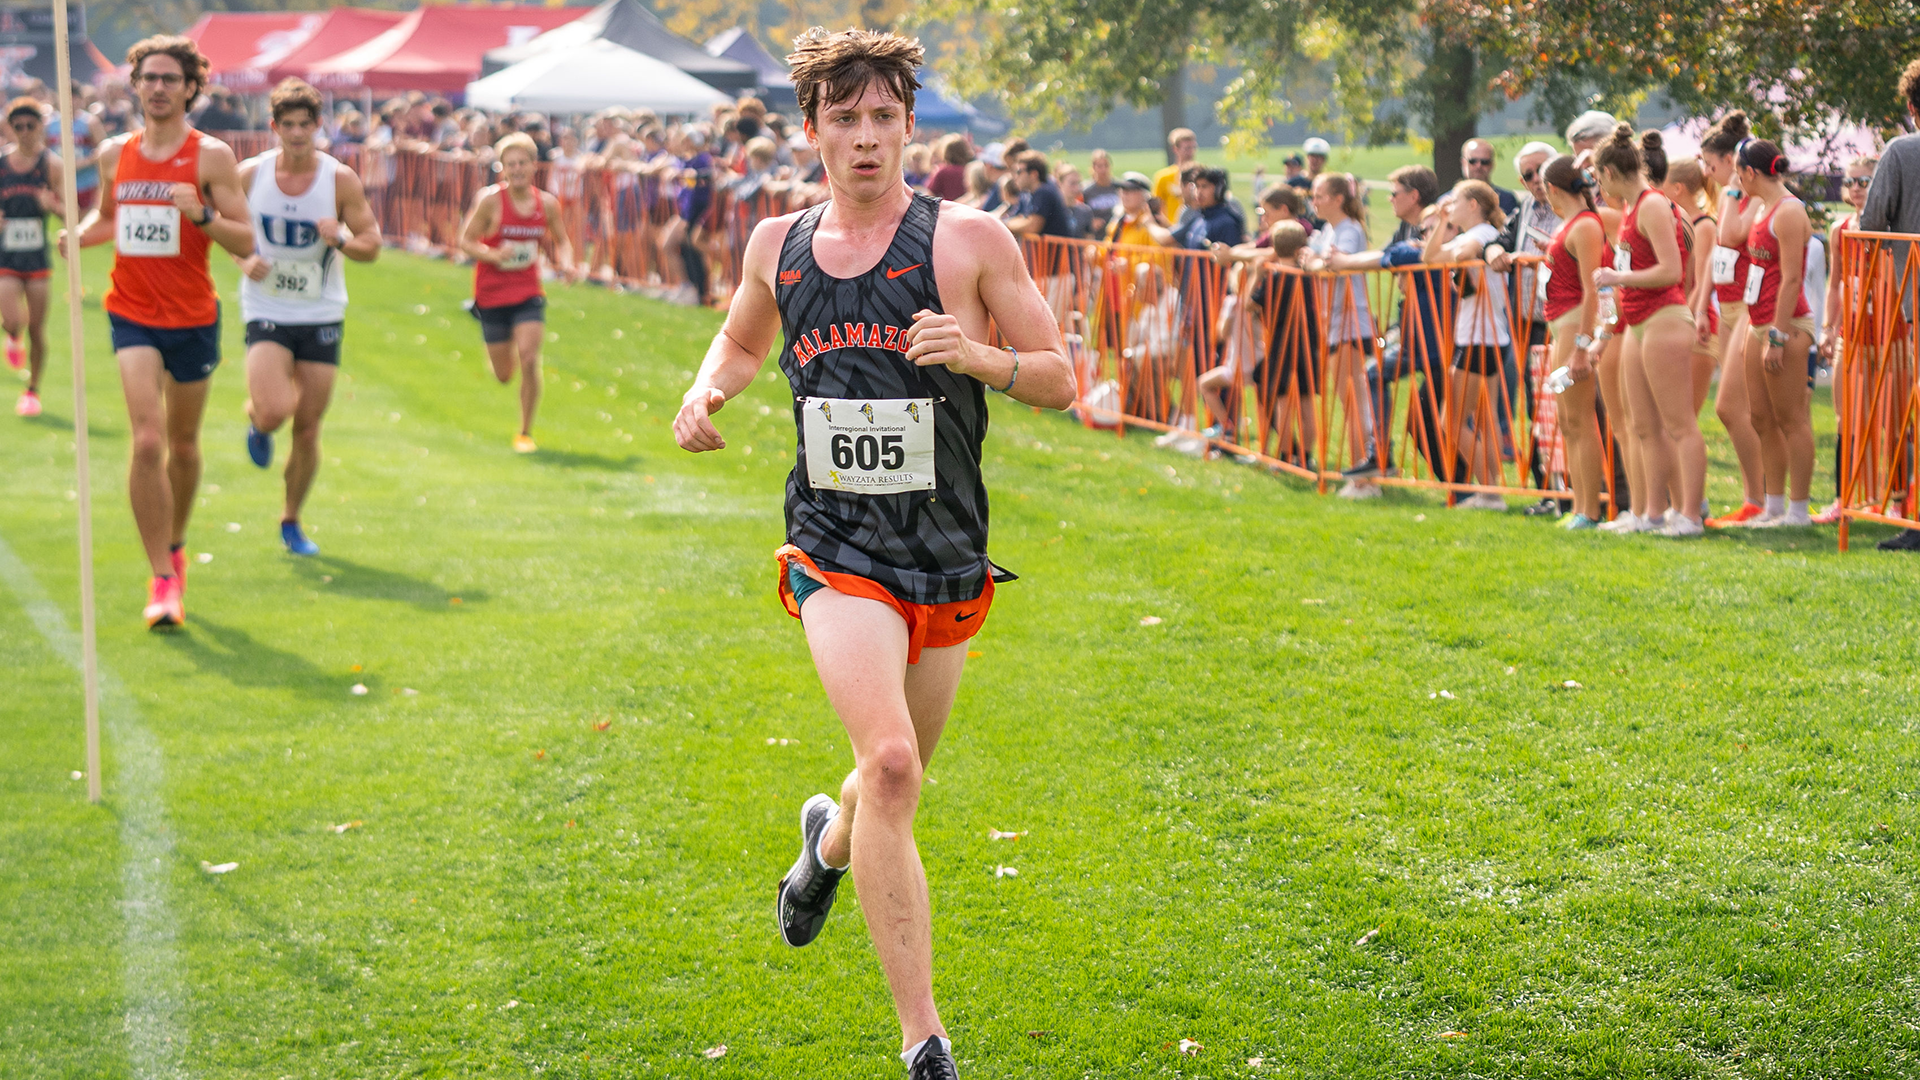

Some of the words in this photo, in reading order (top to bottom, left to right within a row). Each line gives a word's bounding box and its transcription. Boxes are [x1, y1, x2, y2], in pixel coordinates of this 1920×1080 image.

[125, 223, 170, 242] 1425
[275, 274, 309, 292] 392
[793, 322, 912, 368] KALAMAZO
[828, 424, 868, 433] Interregional
[831, 434, 905, 471] 605
[839, 474, 876, 484] WAYZATA
[878, 473, 914, 483] RESULTS
